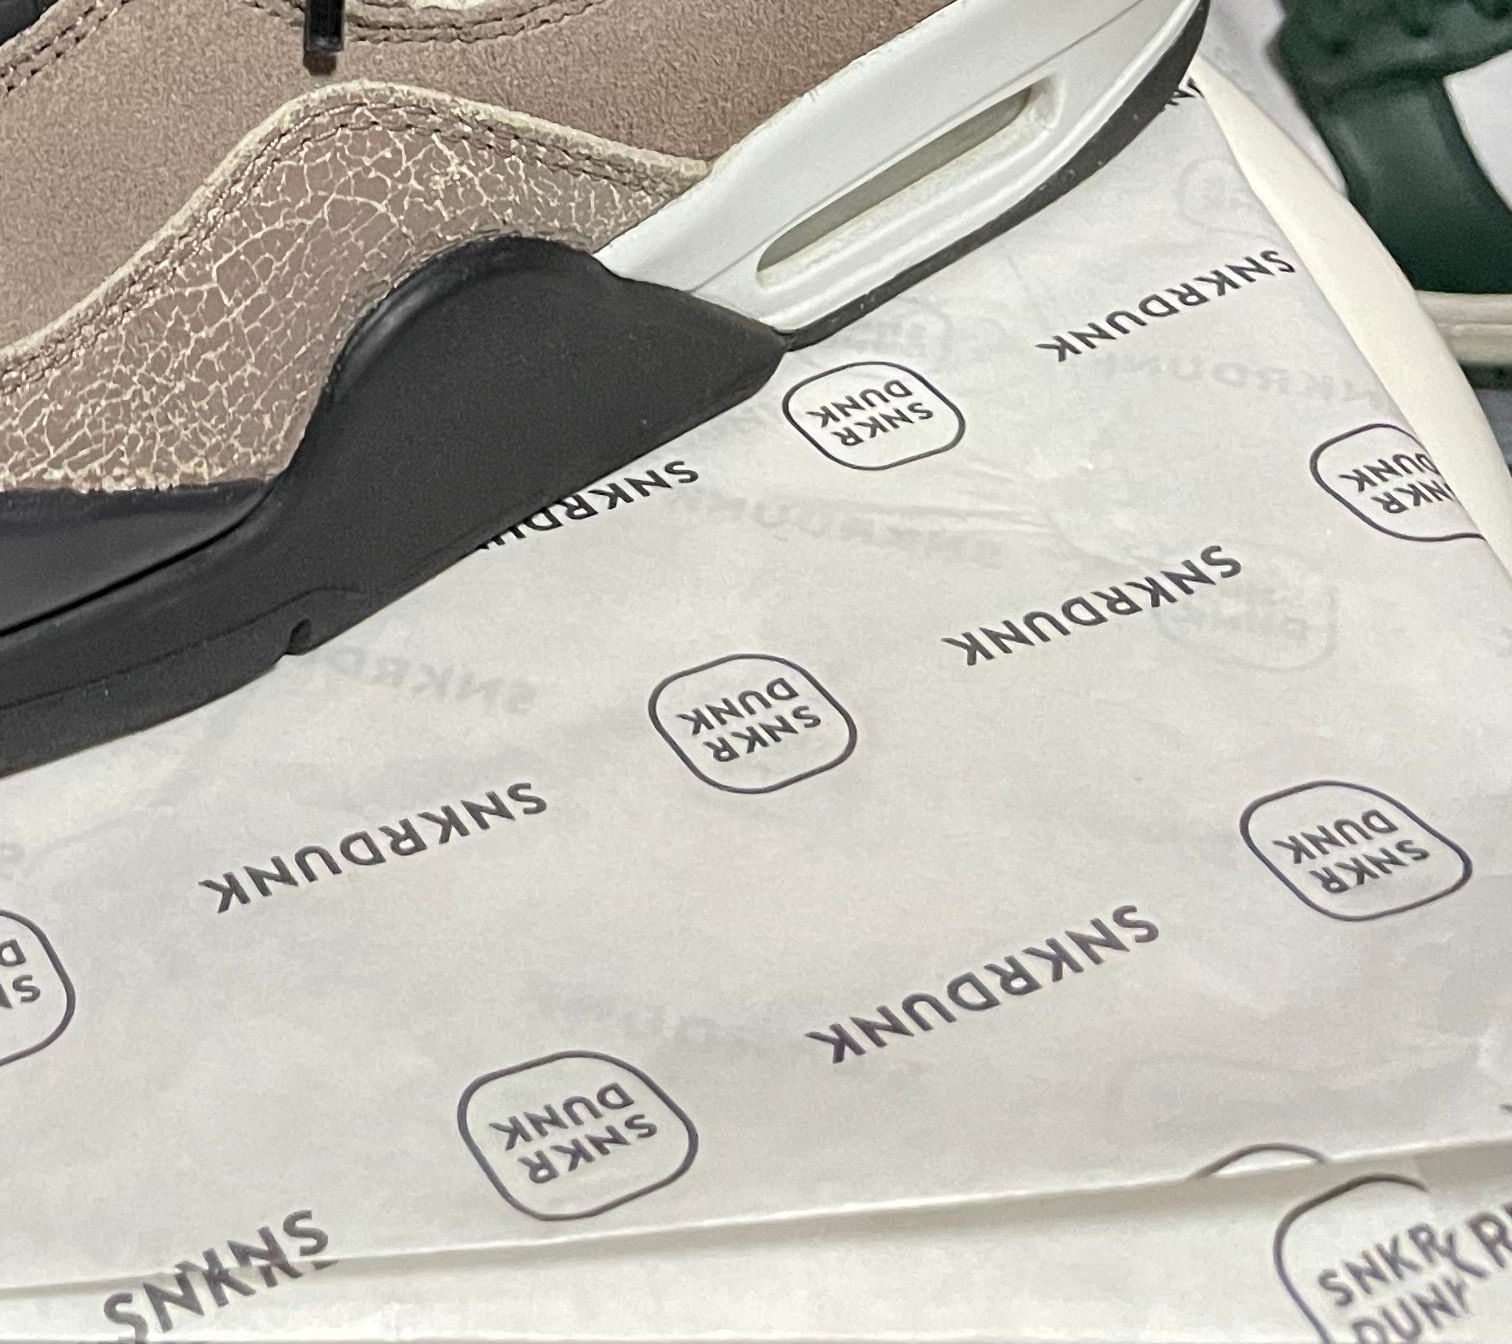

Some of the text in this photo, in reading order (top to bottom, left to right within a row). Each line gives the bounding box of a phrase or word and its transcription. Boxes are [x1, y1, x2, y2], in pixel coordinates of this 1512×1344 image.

[1036, 251, 1295, 362] SNKRDUNK
[806, 379, 914, 428] DUNK
[831, 403, 933, 446] SNKR
[473, 460, 699, 550] SNKRD
[1370, 479, 1455, 514] NKR
[942, 546, 1241, 666] SNKRDUNK
[676, 678, 799, 736] DUNK
[703, 706, 821, 762] SNKR
[199, 783, 546, 913] SNKRDUNK
[1273, 810, 1398, 864] DUNK
[1310, 840, 1429, 894] SNKR
[805, 906, 1158, 1064] SNKRDUNK
